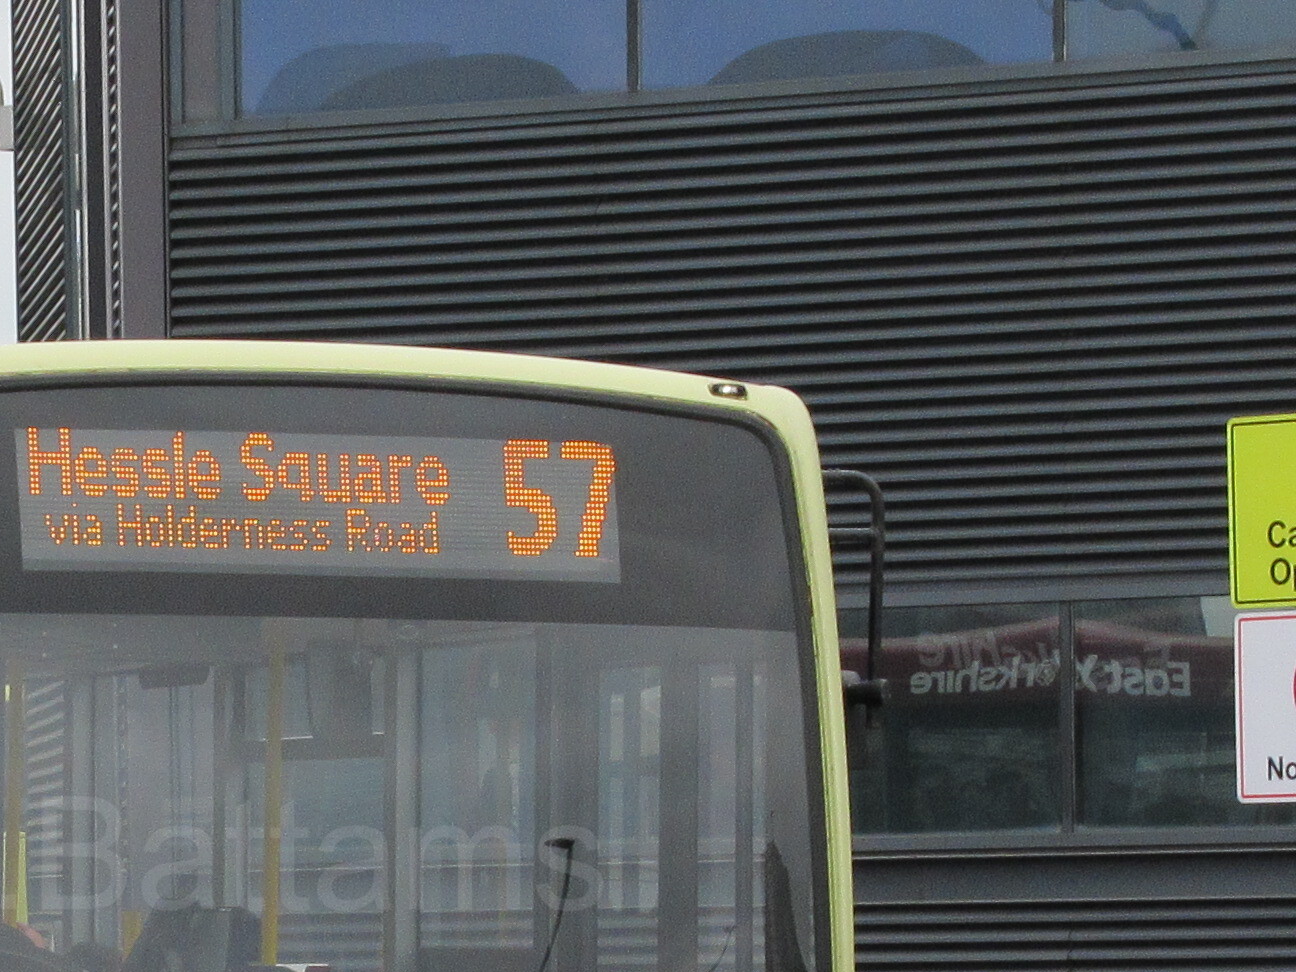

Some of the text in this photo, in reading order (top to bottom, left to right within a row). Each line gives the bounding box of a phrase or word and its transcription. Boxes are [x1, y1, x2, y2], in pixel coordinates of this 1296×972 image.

[26, 427, 452, 504] Hessle Square
[503, 438, 616, 557] 57
[45, 502, 441, 555] via Holderness Road
